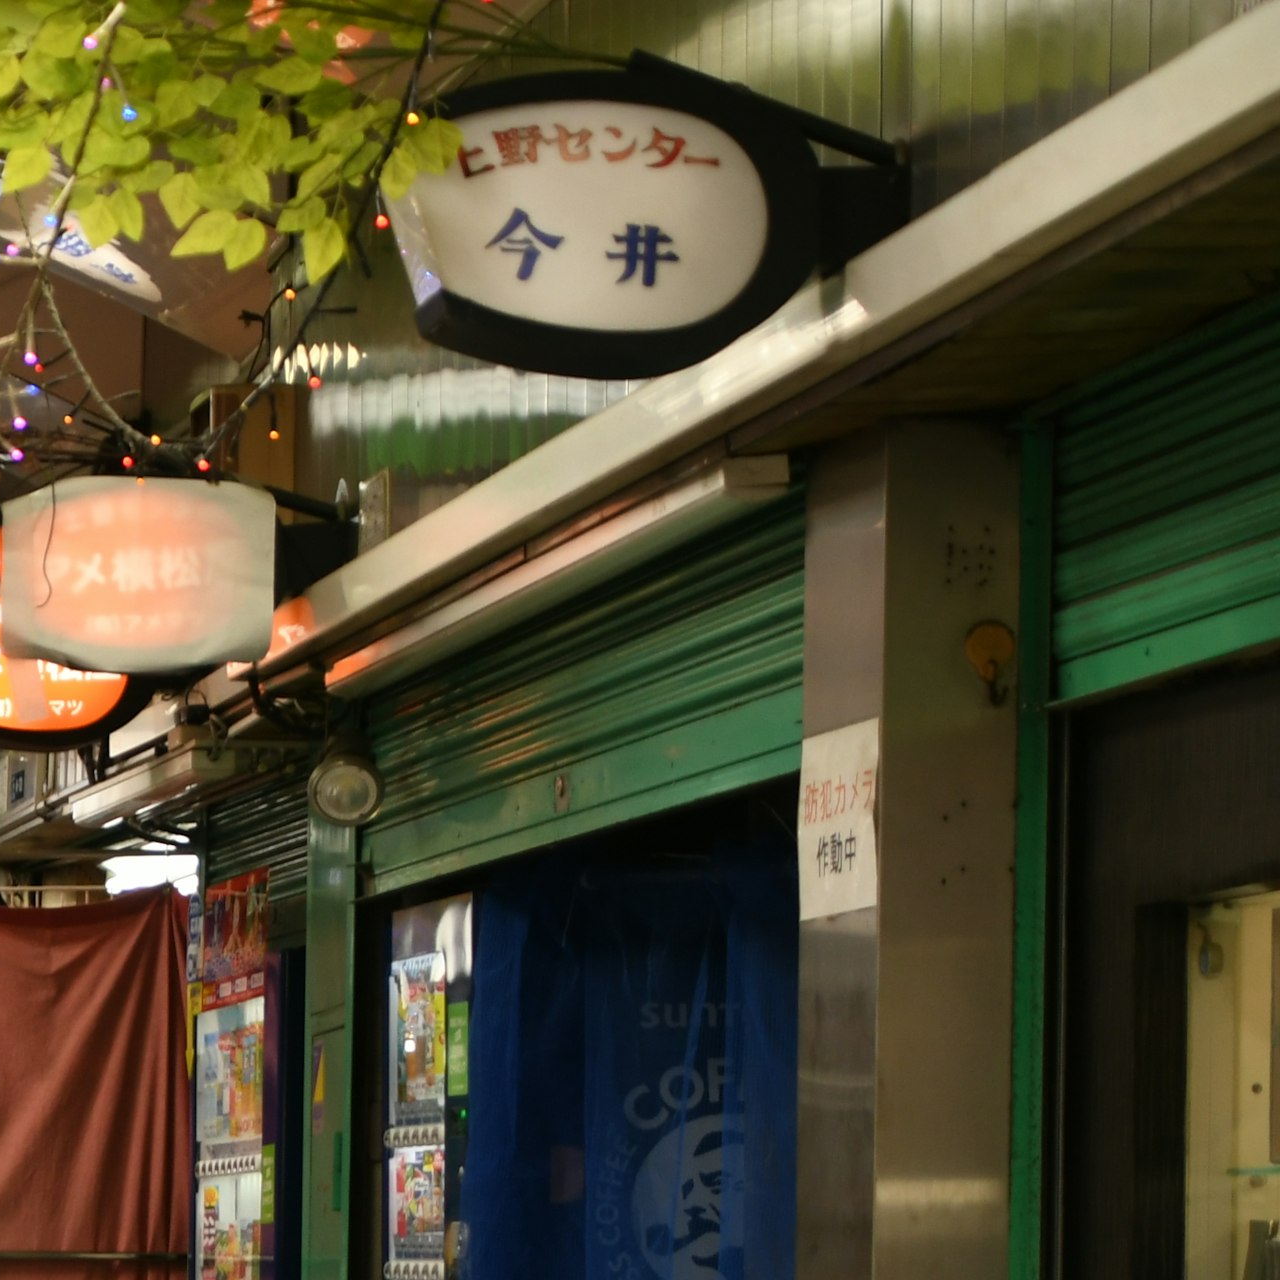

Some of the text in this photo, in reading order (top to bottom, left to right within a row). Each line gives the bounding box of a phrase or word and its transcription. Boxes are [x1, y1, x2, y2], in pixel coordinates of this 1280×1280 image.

[484, 207, 680, 288] 今井
[804, 769, 874, 825] 防犯カメラ
[816, 829, 857, 878] 作動中
